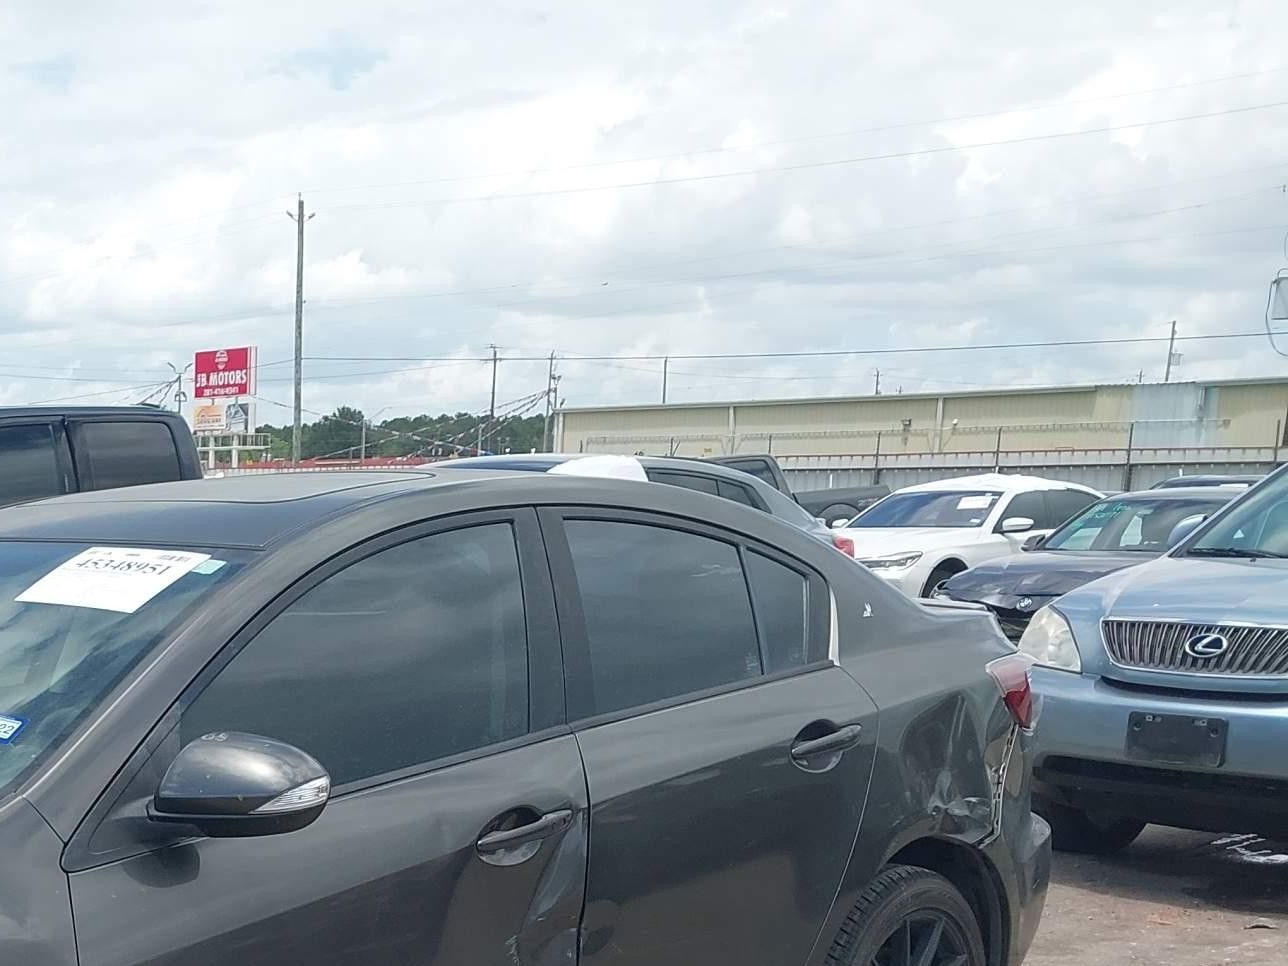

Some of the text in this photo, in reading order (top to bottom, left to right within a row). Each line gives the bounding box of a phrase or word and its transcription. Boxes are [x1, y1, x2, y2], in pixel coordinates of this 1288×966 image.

[196, 369, 247, 388] JB MOTORS
[74, 558, 172, 575] 45348951
